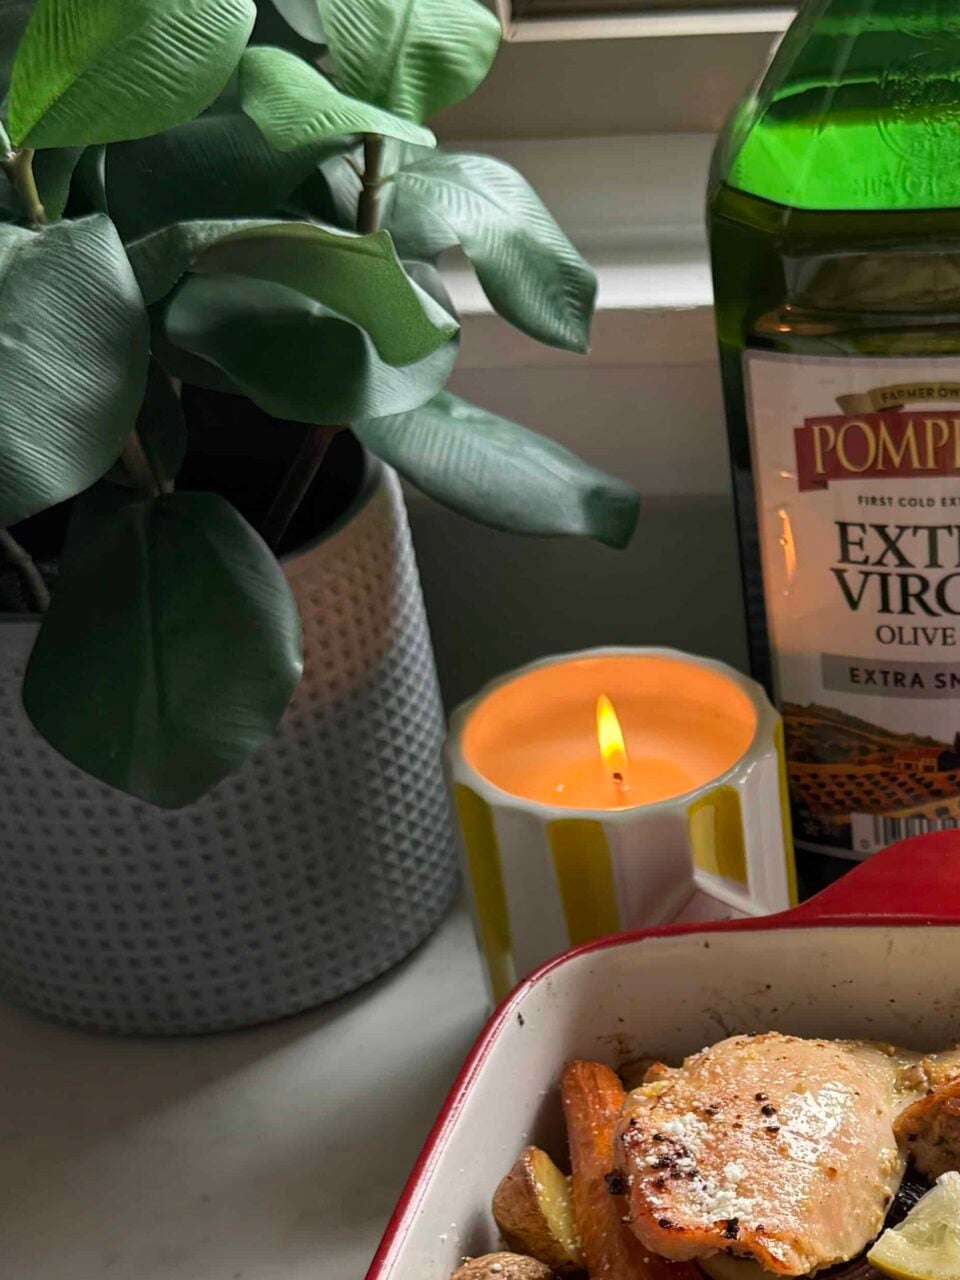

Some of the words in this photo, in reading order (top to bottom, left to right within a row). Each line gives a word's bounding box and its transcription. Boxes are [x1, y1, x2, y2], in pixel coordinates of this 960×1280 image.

[881, 387, 935, 403] FARMER
[857, 495, 894, 507] FIRST
[900, 497, 936, 508] COLD
[875, 625, 957, 647] OLIVE
[849, 667, 924, 689] EXTRA
